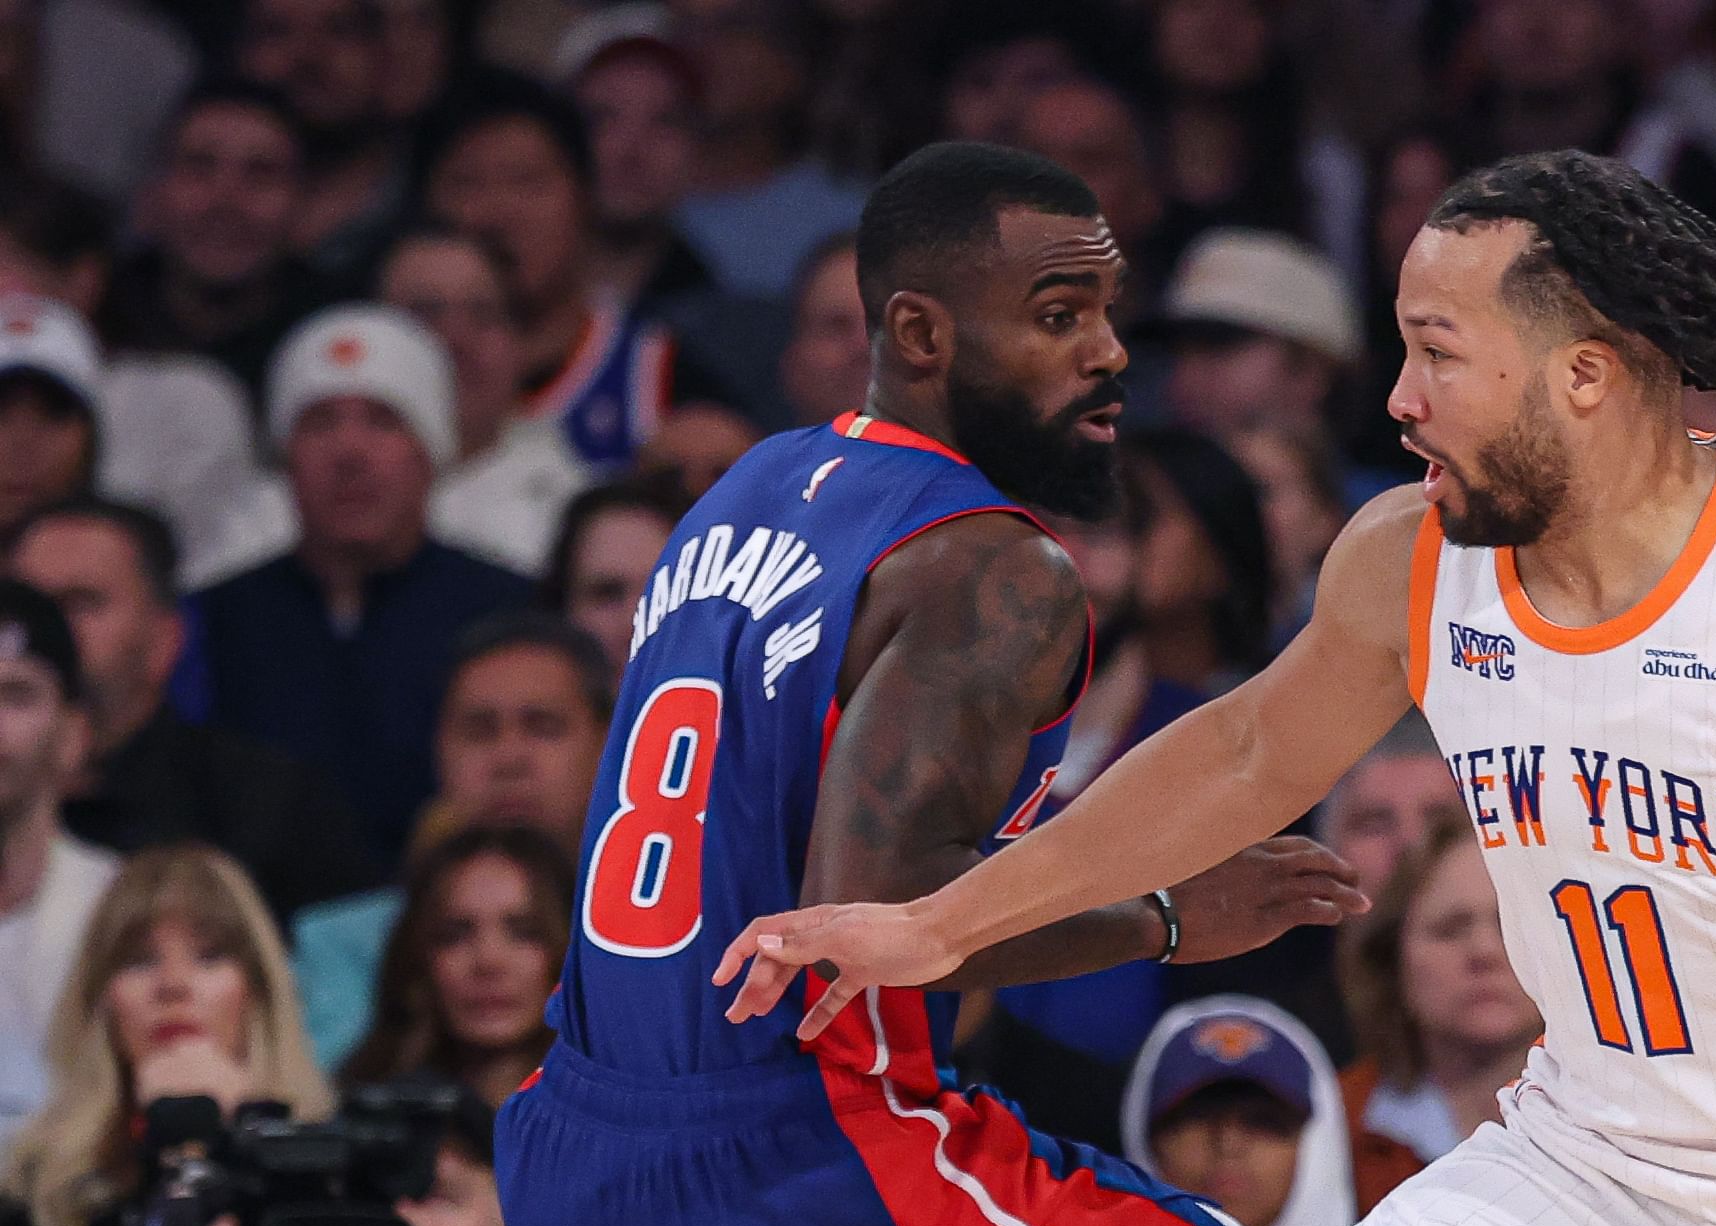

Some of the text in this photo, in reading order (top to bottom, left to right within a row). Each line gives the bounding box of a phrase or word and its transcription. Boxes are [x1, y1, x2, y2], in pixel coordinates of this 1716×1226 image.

[763, 606, 825, 701] JR.
[1448, 622, 1515, 681] NYC
[1642, 659, 1681, 678] abu
[582, 677, 723, 958] 8
[1549, 878, 1695, 1058] 11
